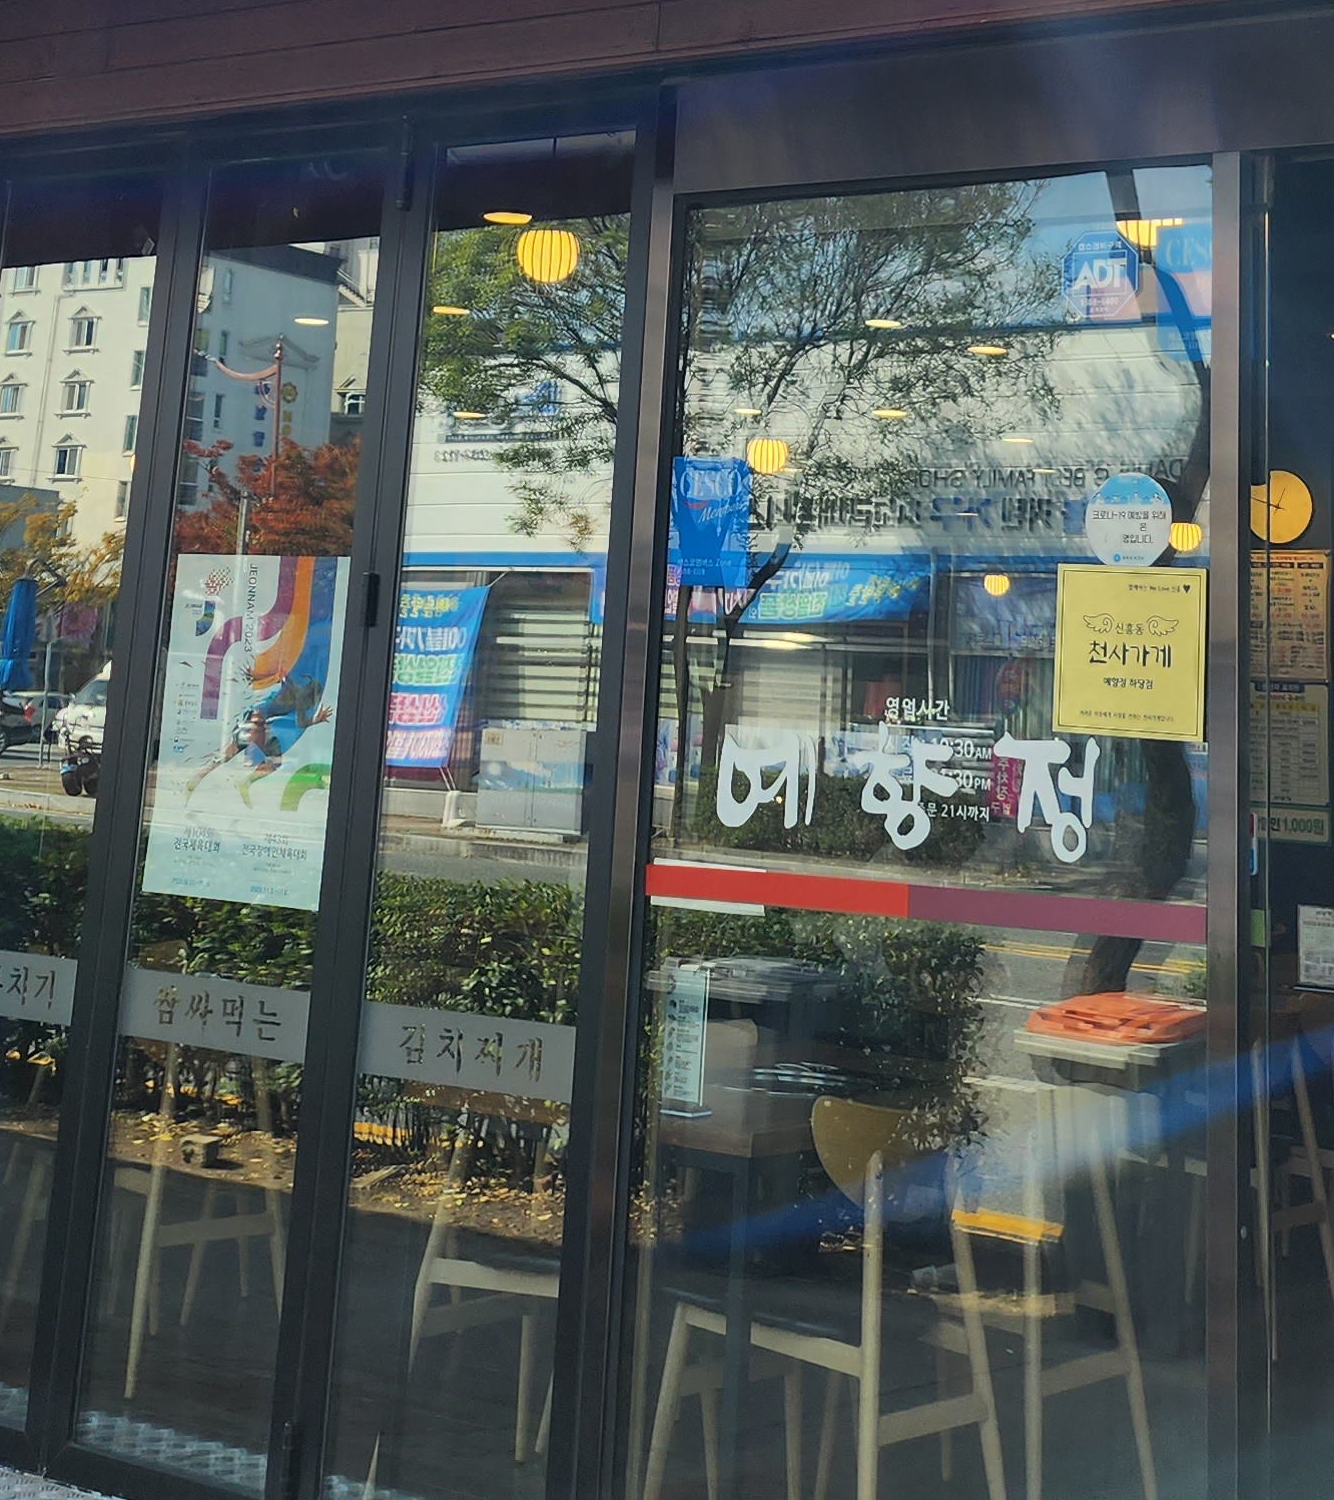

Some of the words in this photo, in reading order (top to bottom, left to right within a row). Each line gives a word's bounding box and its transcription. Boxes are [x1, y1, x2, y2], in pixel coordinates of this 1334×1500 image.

[1073, 258, 1126, 289] ADT
[246, 563, 258, 623] JEONNAM
[244, 624, 254, 652] 2023
[1115, 623, 1144, 635] 신흥동
[1089, 640, 1172, 668] 천사가게
[885, 697, 950, 721] 영업시간
[941, 804, 990, 822] 21시까지
[154, 986, 282, 1041] 쌈싸먹는
[398, 1023, 544, 1082] 김치찌개
